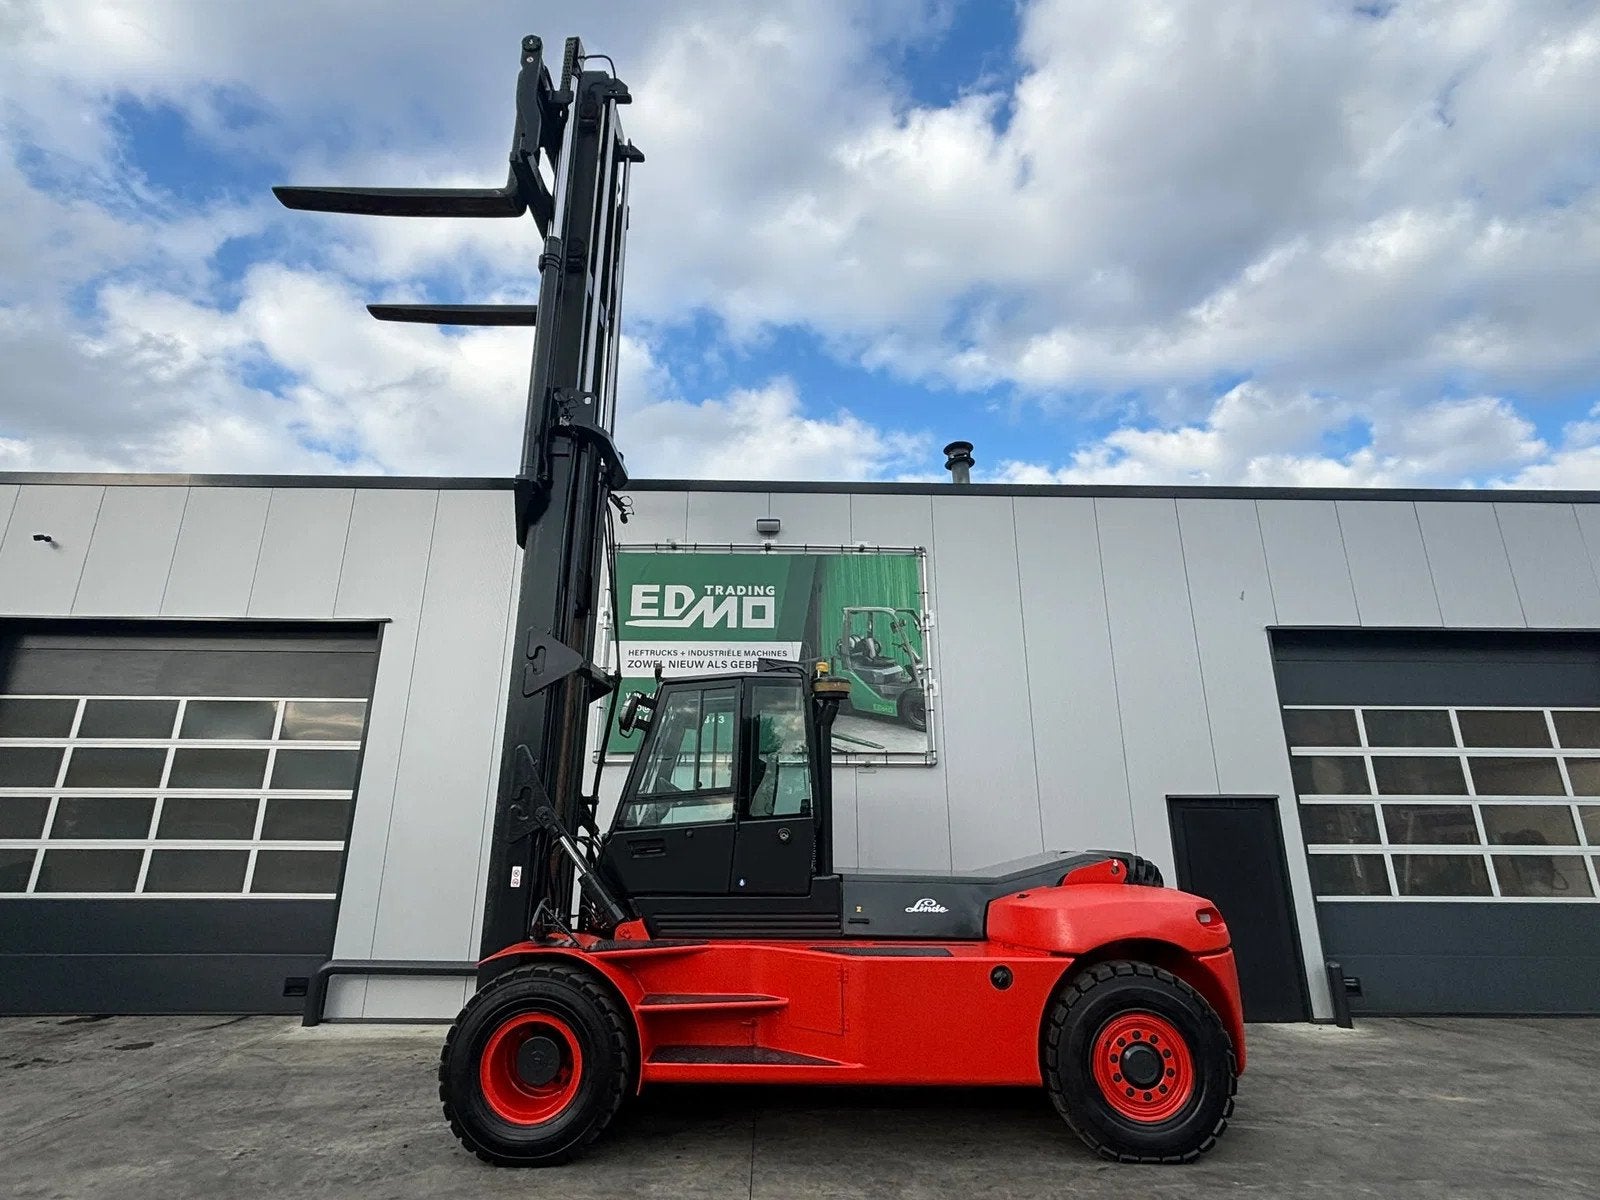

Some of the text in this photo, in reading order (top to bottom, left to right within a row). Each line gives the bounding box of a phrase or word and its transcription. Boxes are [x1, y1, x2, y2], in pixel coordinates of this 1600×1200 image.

[705, 585, 775, 596] TRADING
[625, 584, 775, 629] EDMO
[628, 649, 678, 657] HEFTRUCKS
[744, 649, 788, 657] MACHINES
[668, 660, 704, 669] NIEUW
[707, 660, 728, 669] ALS
[905, 898, 949, 913] Linde
